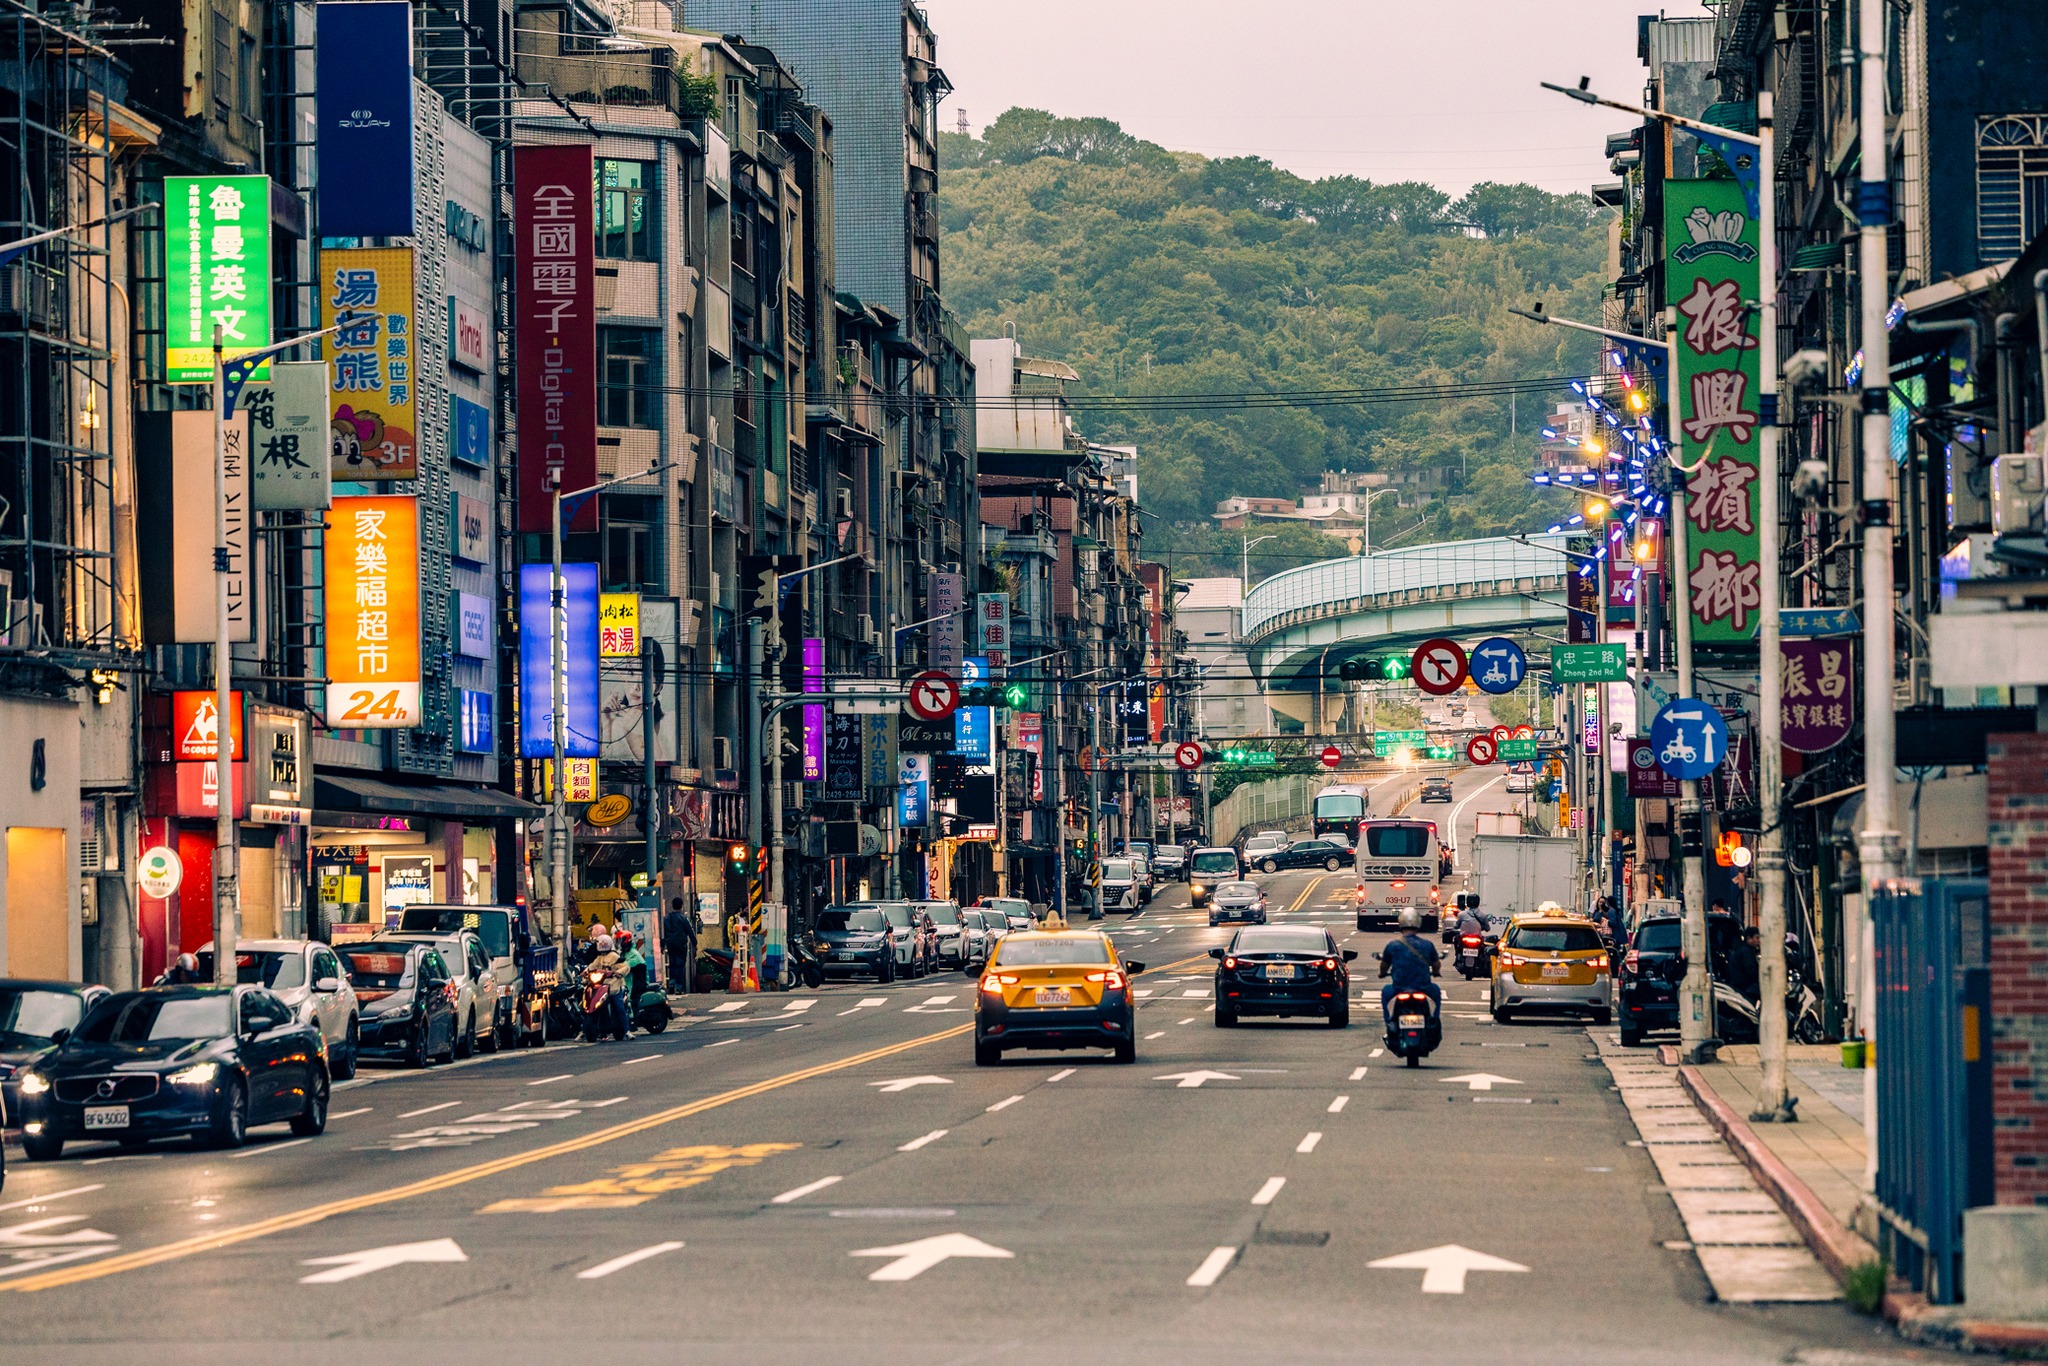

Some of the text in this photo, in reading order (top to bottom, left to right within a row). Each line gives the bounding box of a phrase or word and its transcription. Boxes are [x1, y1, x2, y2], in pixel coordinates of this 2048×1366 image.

[208, 184, 247, 341] 魯曼英文
[533, 185, 577, 333] 全國電子
[332, 268, 383, 393] 湯姆熊
[387, 314, 408, 406] 歡樂世界
[378, 440, 411, 465] 3F
[355, 507, 389, 676] 家樂福超市
[1563, 650, 1614, 664] 忠二路
[1563, 669, 1586, 678] Zhong
[1588, 668, 1602, 677] 2nd
[341, 689, 408, 721] 24h
[1503, 743, 1531, 751] 忠三路
